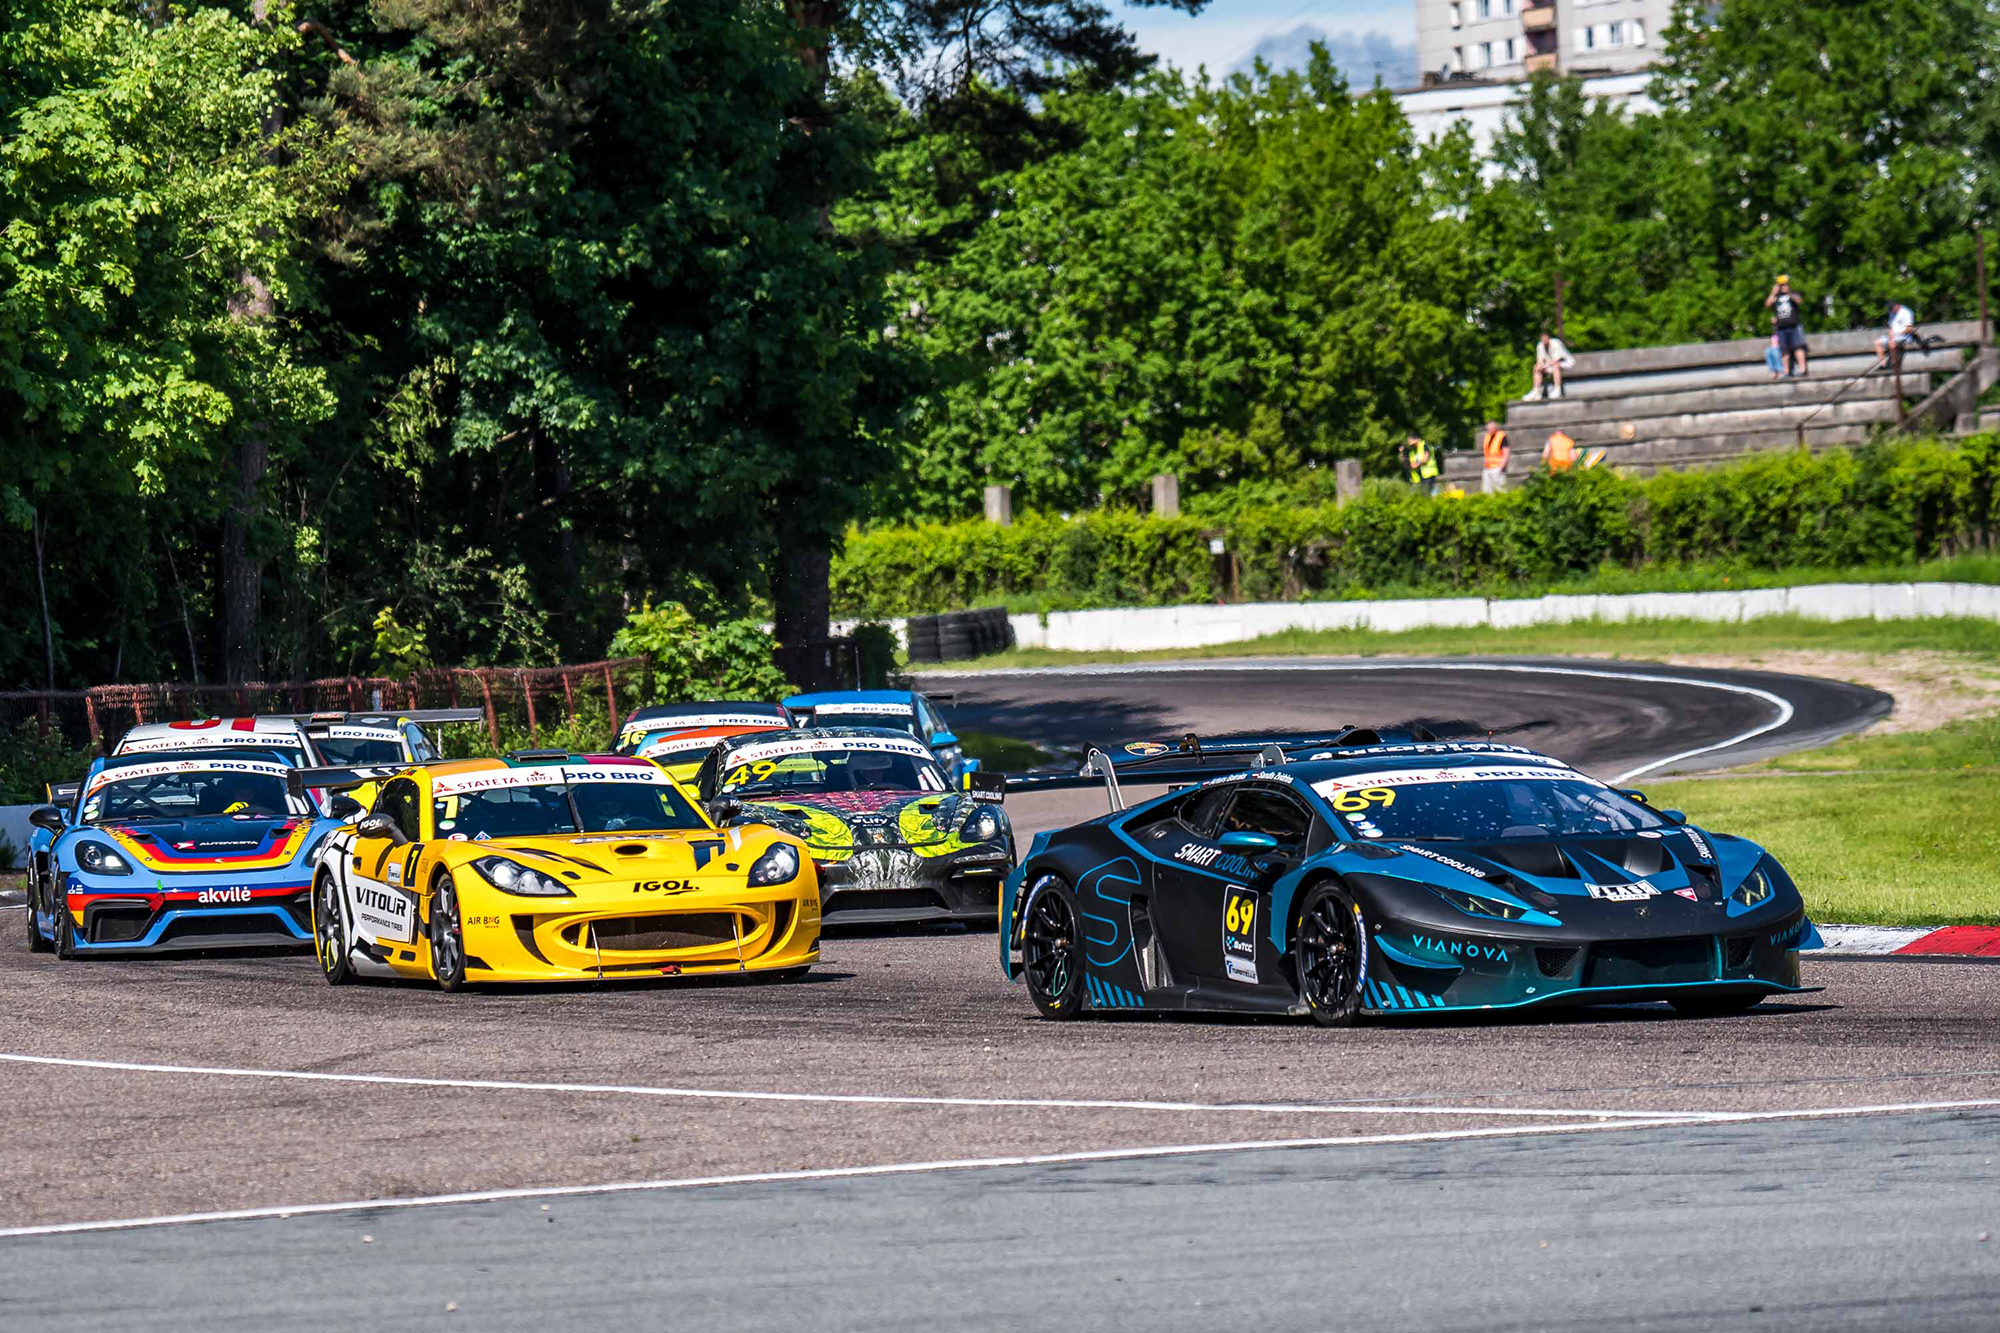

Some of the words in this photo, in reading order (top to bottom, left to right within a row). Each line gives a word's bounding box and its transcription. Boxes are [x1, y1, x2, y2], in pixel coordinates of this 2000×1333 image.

[138, 741, 187, 751] STATETA
[620, 730, 648, 749] 16
[751, 745, 804, 758] STATETA
[115, 766, 170, 779] STATETA
[209, 762, 248, 770] PRO
[725, 761, 778, 785] 49
[457, 777, 519, 790] STATETA
[565, 772, 606, 780] PRO
[730, 799, 741, 807] IGO
[1333, 787, 1397, 812] 69
[407, 850, 419, 879] 1
[1174, 843, 1222, 867] SMART
[1399, 844, 1440, 859] SMART
[1436, 854, 1486, 878] COOLING
[198, 886, 251, 903] akvilė
[356, 886, 407, 917] VITOUR
[361, 912, 391, 929] PERFORMANCE
[391, 922, 403, 932] TIRES
[467, 916, 481, 925] AIR
[1226, 895, 1254, 936] 69
[1413, 934, 1509, 962] VIANOVA
